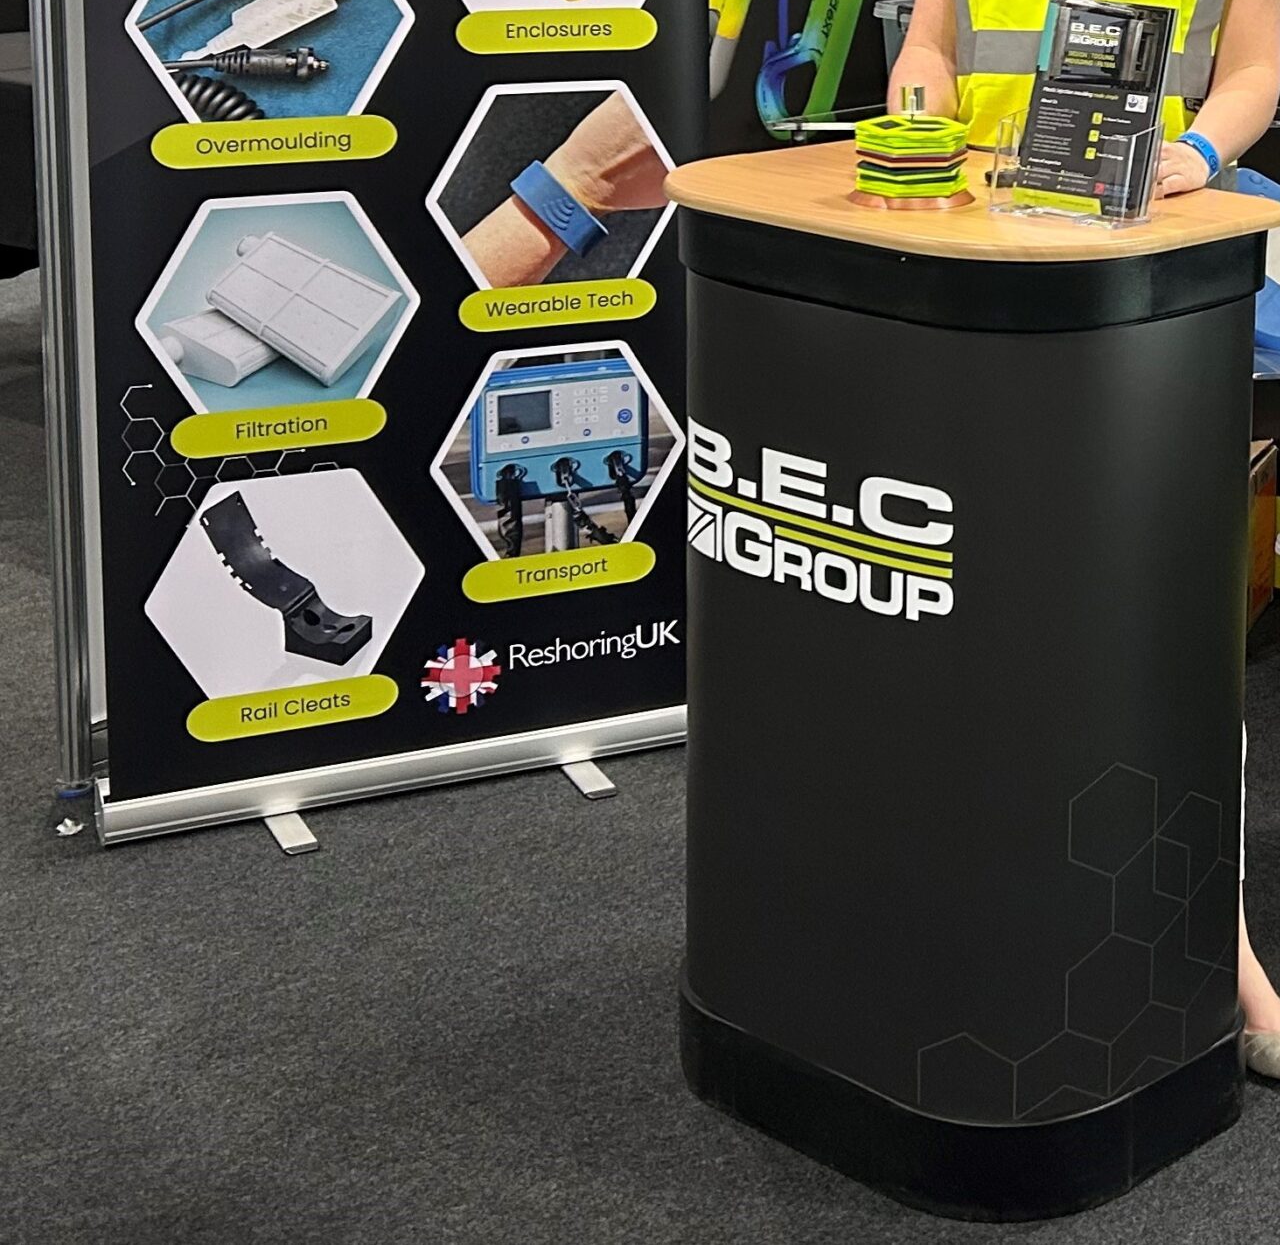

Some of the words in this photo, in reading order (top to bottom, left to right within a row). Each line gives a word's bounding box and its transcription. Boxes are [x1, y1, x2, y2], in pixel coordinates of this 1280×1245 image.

[505, 20, 613, 40] Enclosures
[1070, 22, 1121, 36] B.E.C
[195, 131, 352, 156] Overmoulding
[485, 294, 582, 318] Wearable
[587, 289, 634, 309] Tech
[235, 415, 328, 440] Filtration
[688, 416, 954, 545] B.E.C
[515, 558, 608, 585] Transport
[724, 511, 954, 621] GROUP
[508, 619, 681, 669] ReshoringUK
[240, 701, 278, 723] Rail
[284, 692, 351, 716] Cleats
